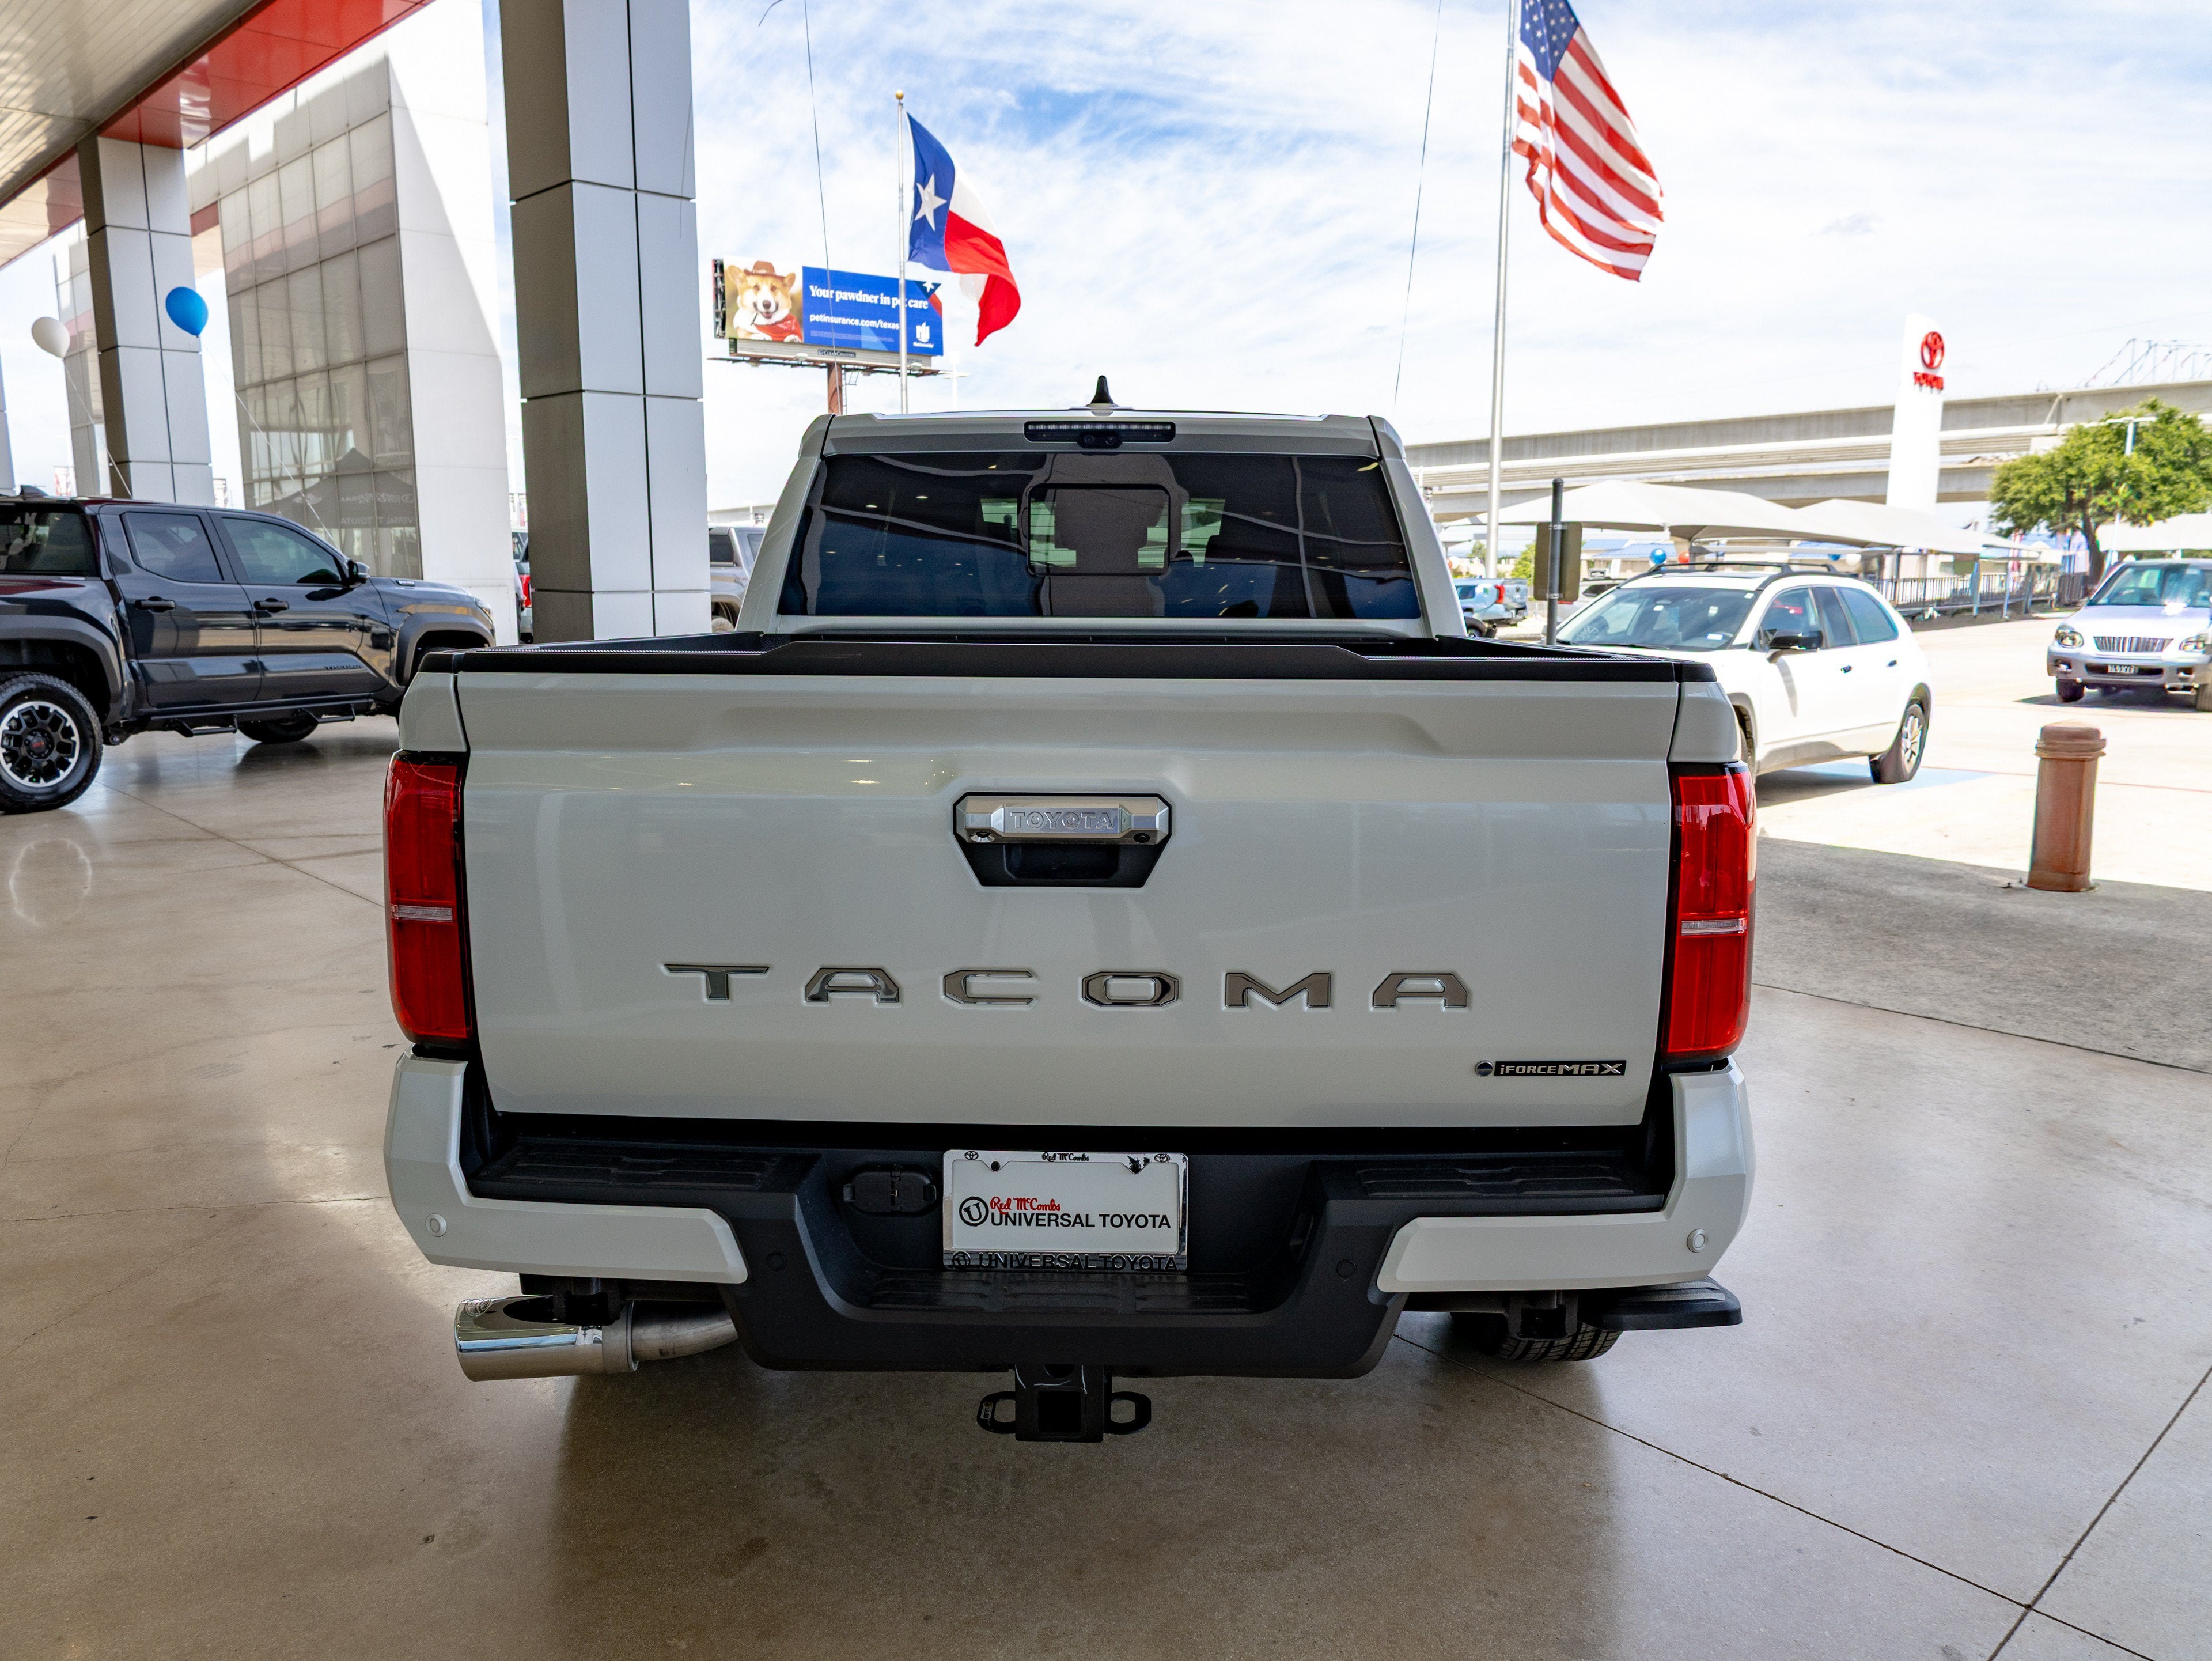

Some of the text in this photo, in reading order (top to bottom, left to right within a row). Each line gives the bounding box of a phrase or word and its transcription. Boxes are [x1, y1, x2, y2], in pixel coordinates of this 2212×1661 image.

[809, 285, 834, 298] Your
[835, 290, 878, 305] pawdner
[880, 294, 891, 305] in
[908, 299, 928, 309] care
[809, 313, 899, 330] petinsurance.com/texas
[1010, 811, 1113, 830] TOYOTA
[664, 964, 1468, 1008] TACOMA
[1041, 1152, 1089, 1162] Red McCombs
[990, 1196, 1060, 1214] Red McCombs
[991, 1212, 1171, 1229] UNIVERSAL TOYOTA
[979, 1252, 1096, 1269] UNIVERSAL
[1099, 1254, 1179, 1271] TOYOTA
